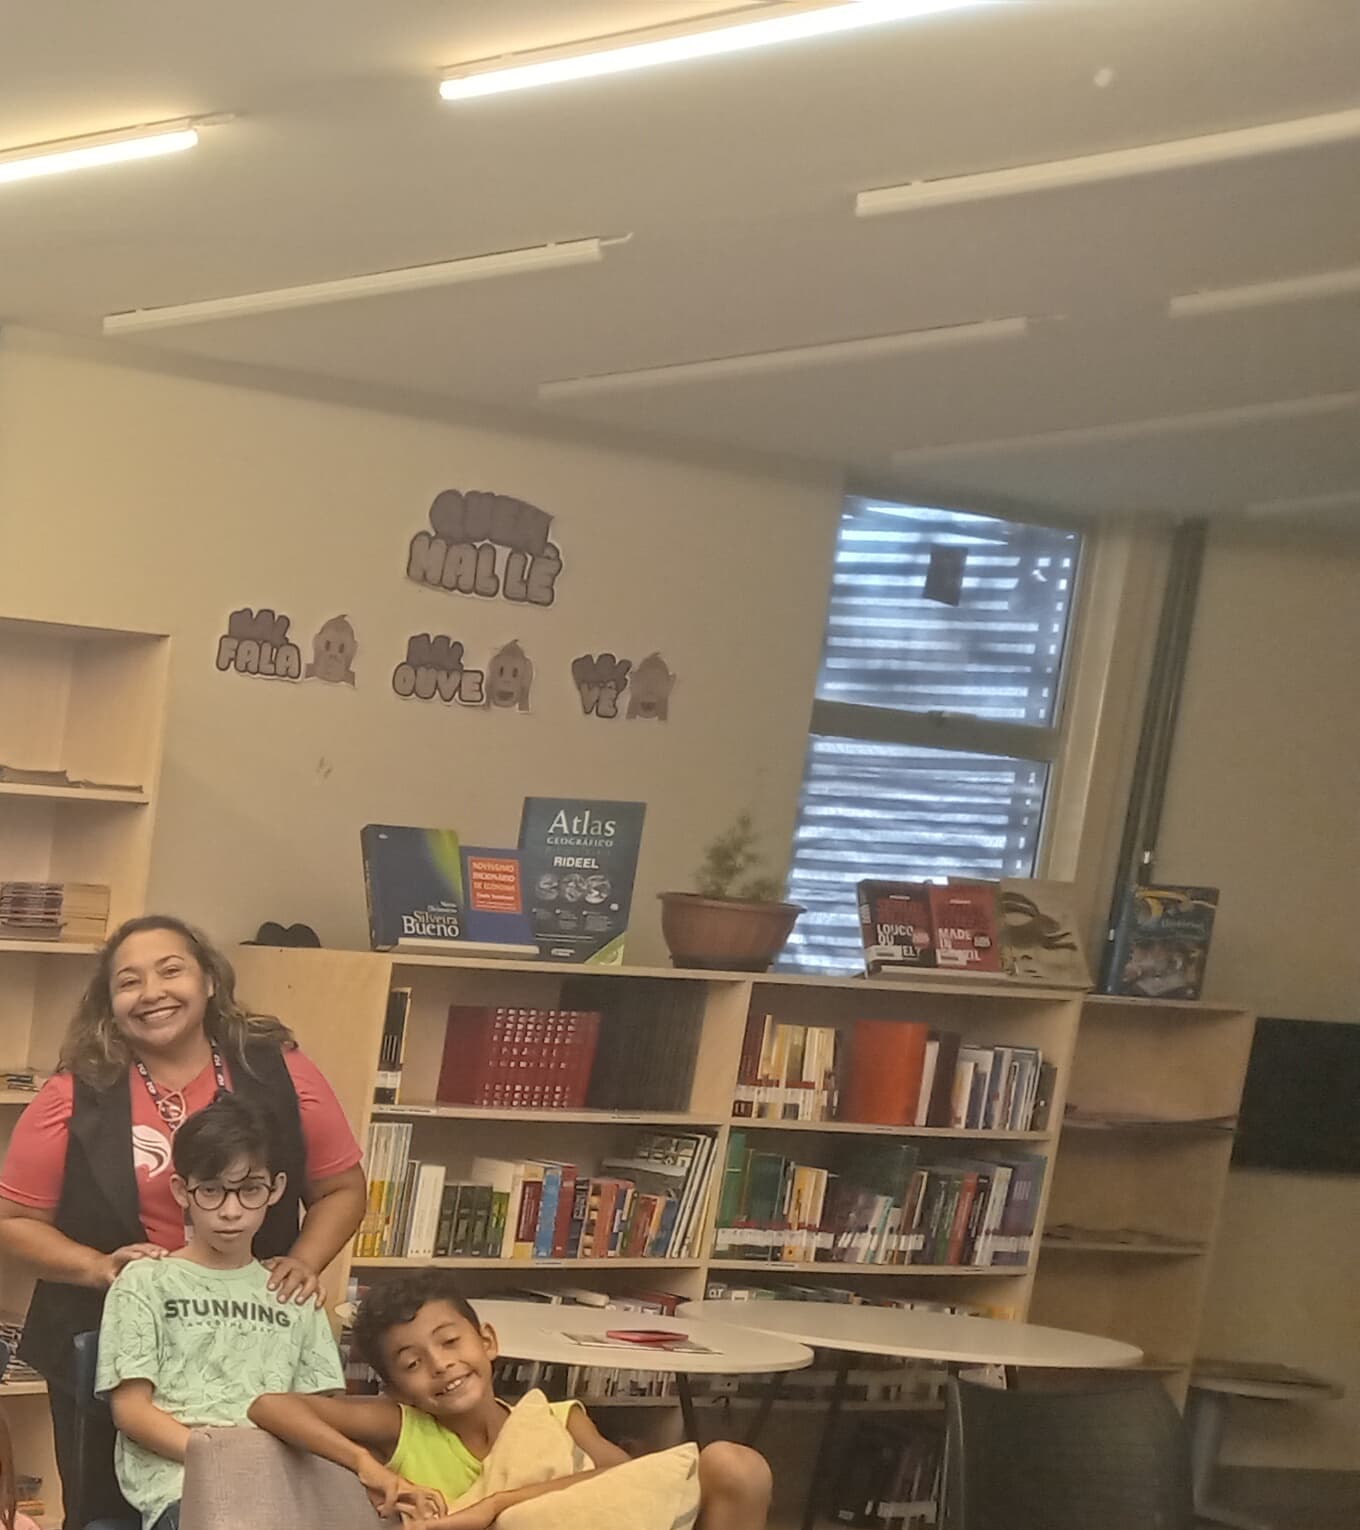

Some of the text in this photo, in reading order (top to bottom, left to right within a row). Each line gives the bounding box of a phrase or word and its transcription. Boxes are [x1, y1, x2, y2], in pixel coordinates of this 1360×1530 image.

[216, 635, 301, 679] FALA
[392, 662, 484, 702] OUVE
[548, 809, 617, 837] Atlas
[553, 856, 600, 870] RIDEEL
[401, 915, 460, 937] Bueno
[163, 1299, 291, 1328] STUNNING
